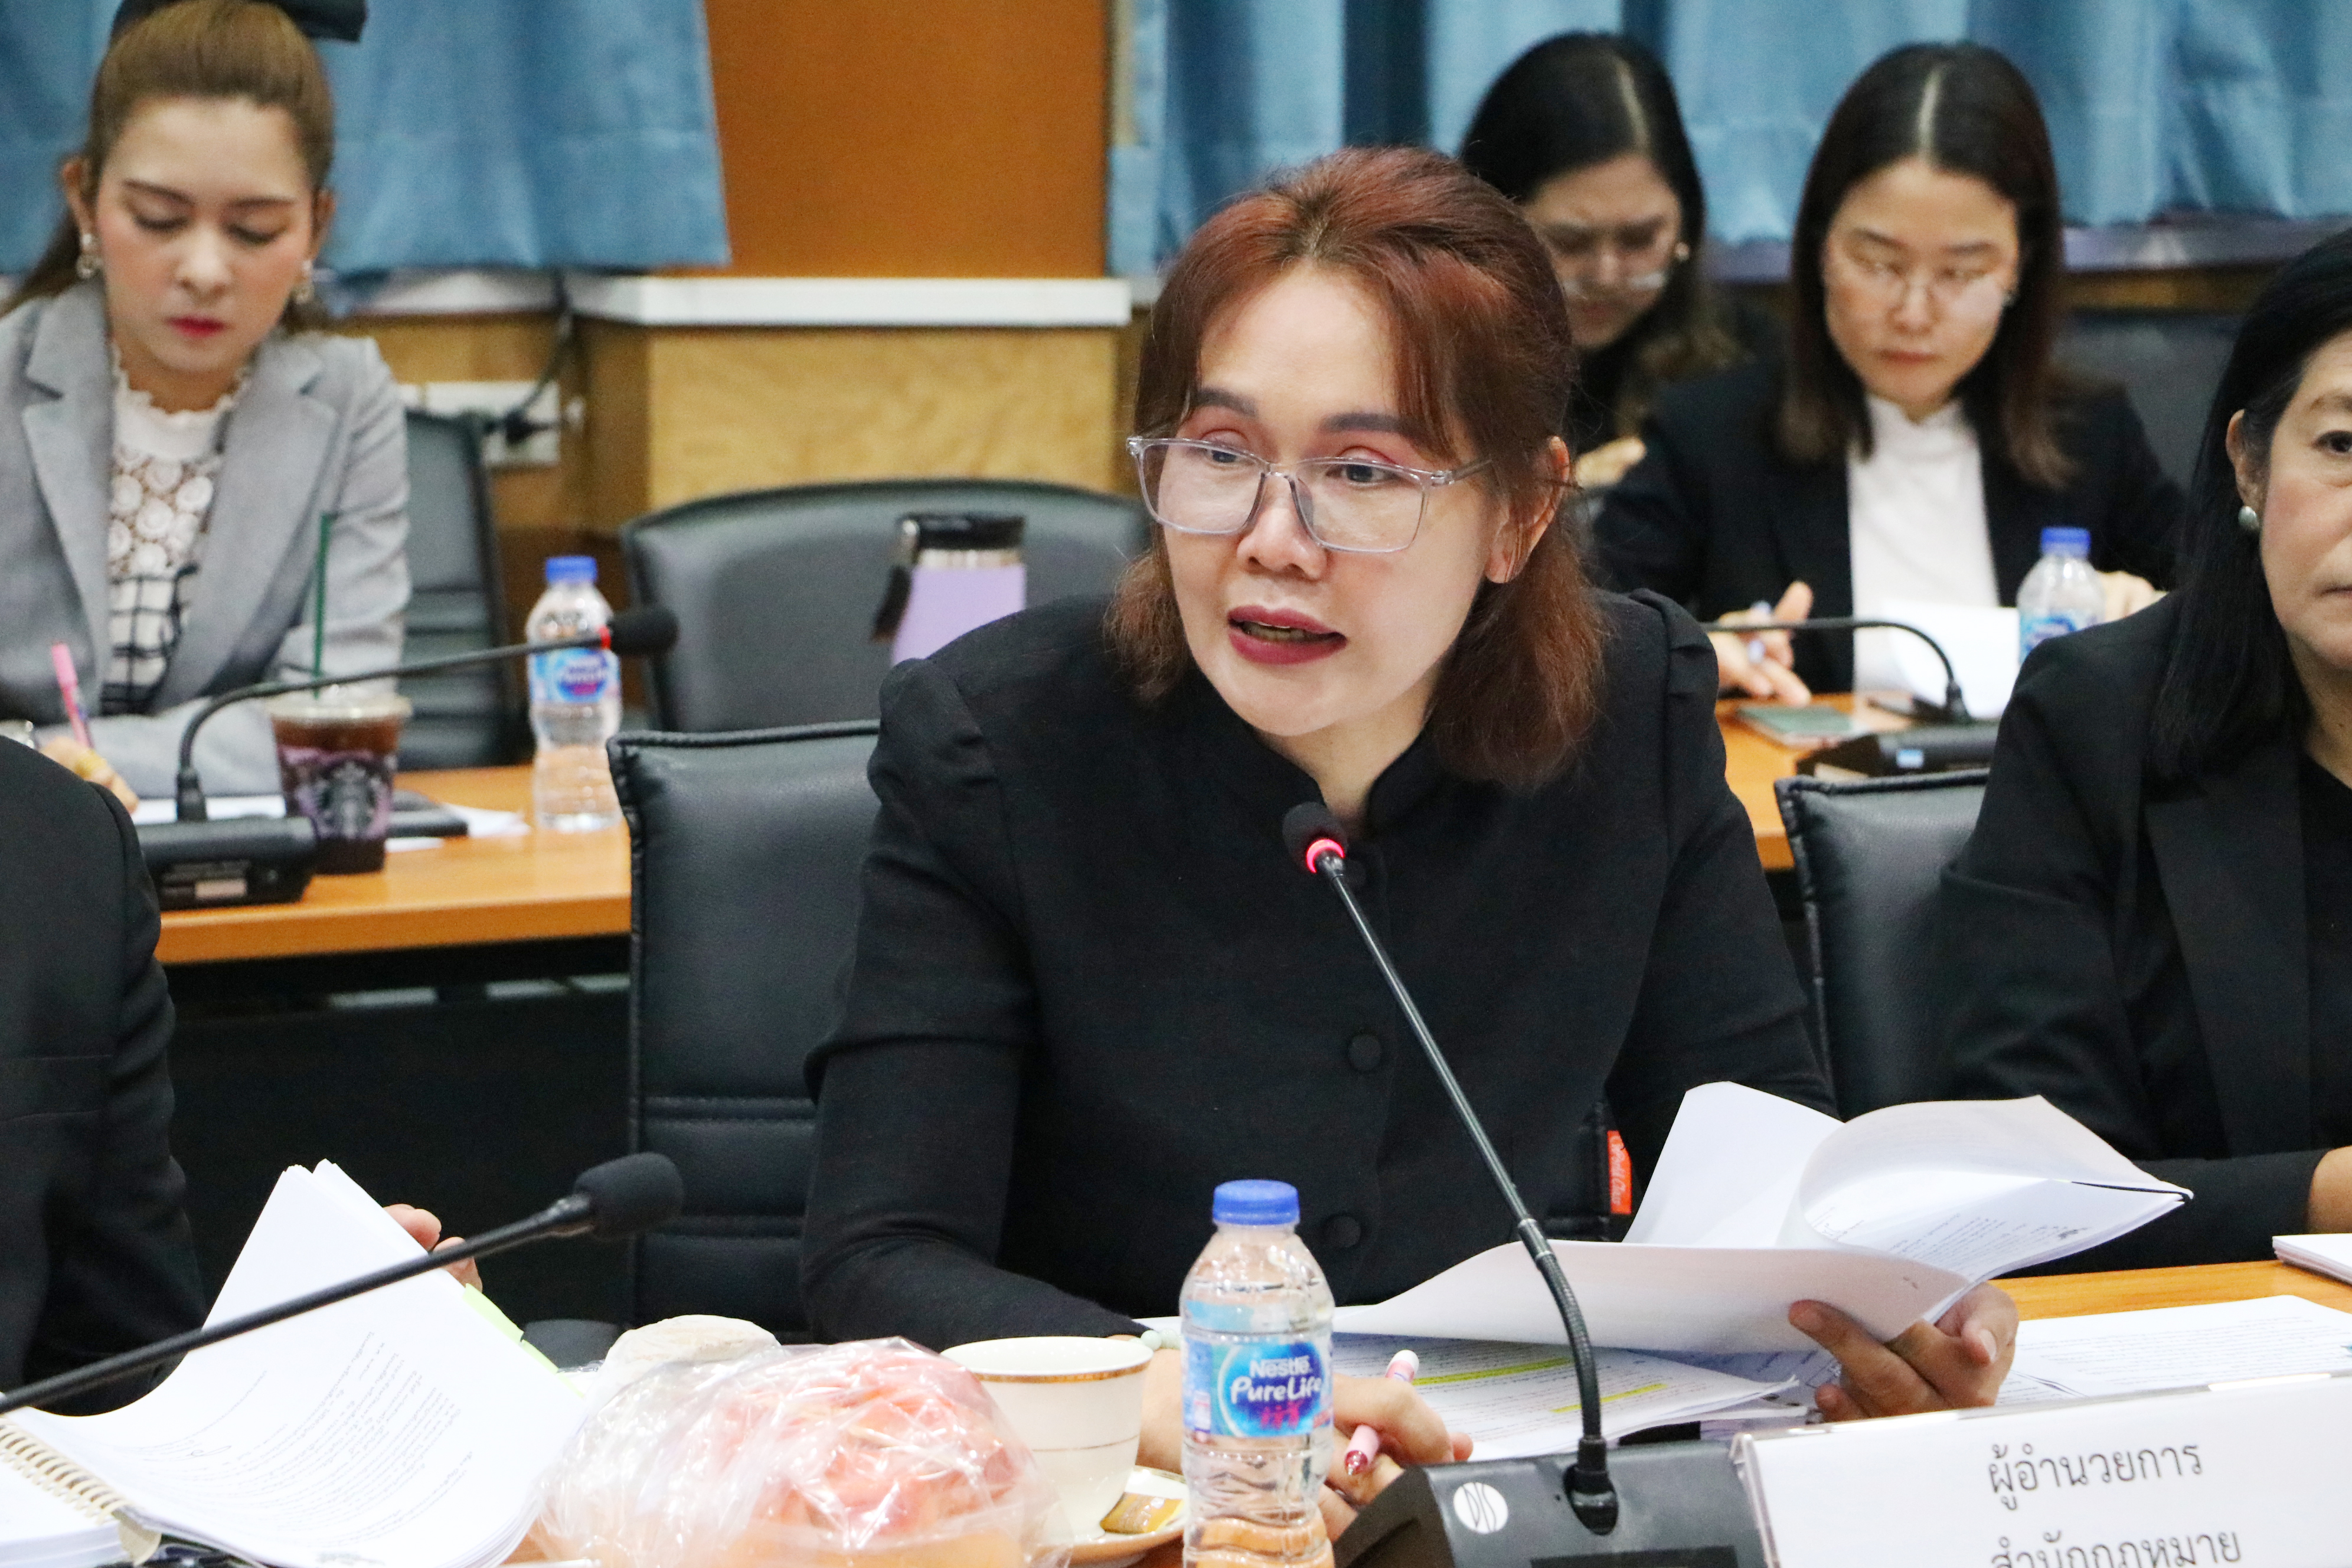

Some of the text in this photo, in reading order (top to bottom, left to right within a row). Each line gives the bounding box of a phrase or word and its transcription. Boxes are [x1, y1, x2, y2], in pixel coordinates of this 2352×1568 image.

[1989, 1443, 2203, 1510] ผู้อำนวยการ
